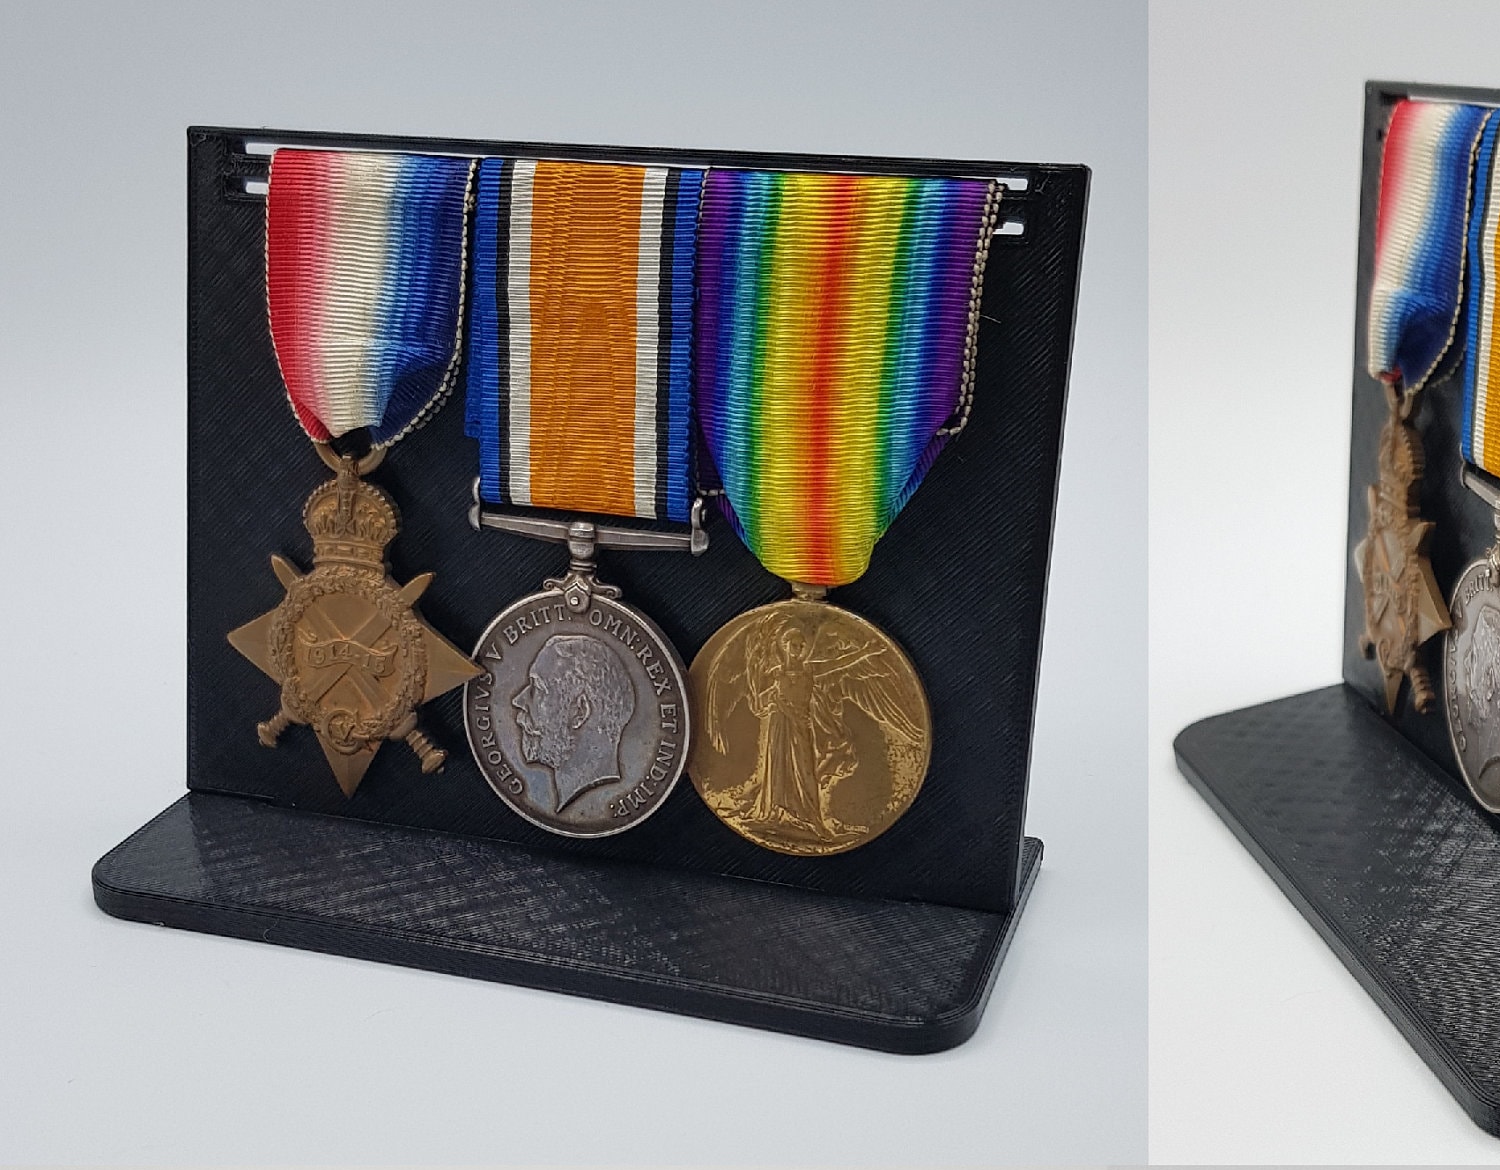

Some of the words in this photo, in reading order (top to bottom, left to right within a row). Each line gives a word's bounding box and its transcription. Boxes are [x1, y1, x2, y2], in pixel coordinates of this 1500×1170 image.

[485, 641, 502, 660] V
[636, 643, 672, 696] REX
[474, 671, 524, 795] GEORGIVS
[660, 703, 677, 734] ET
